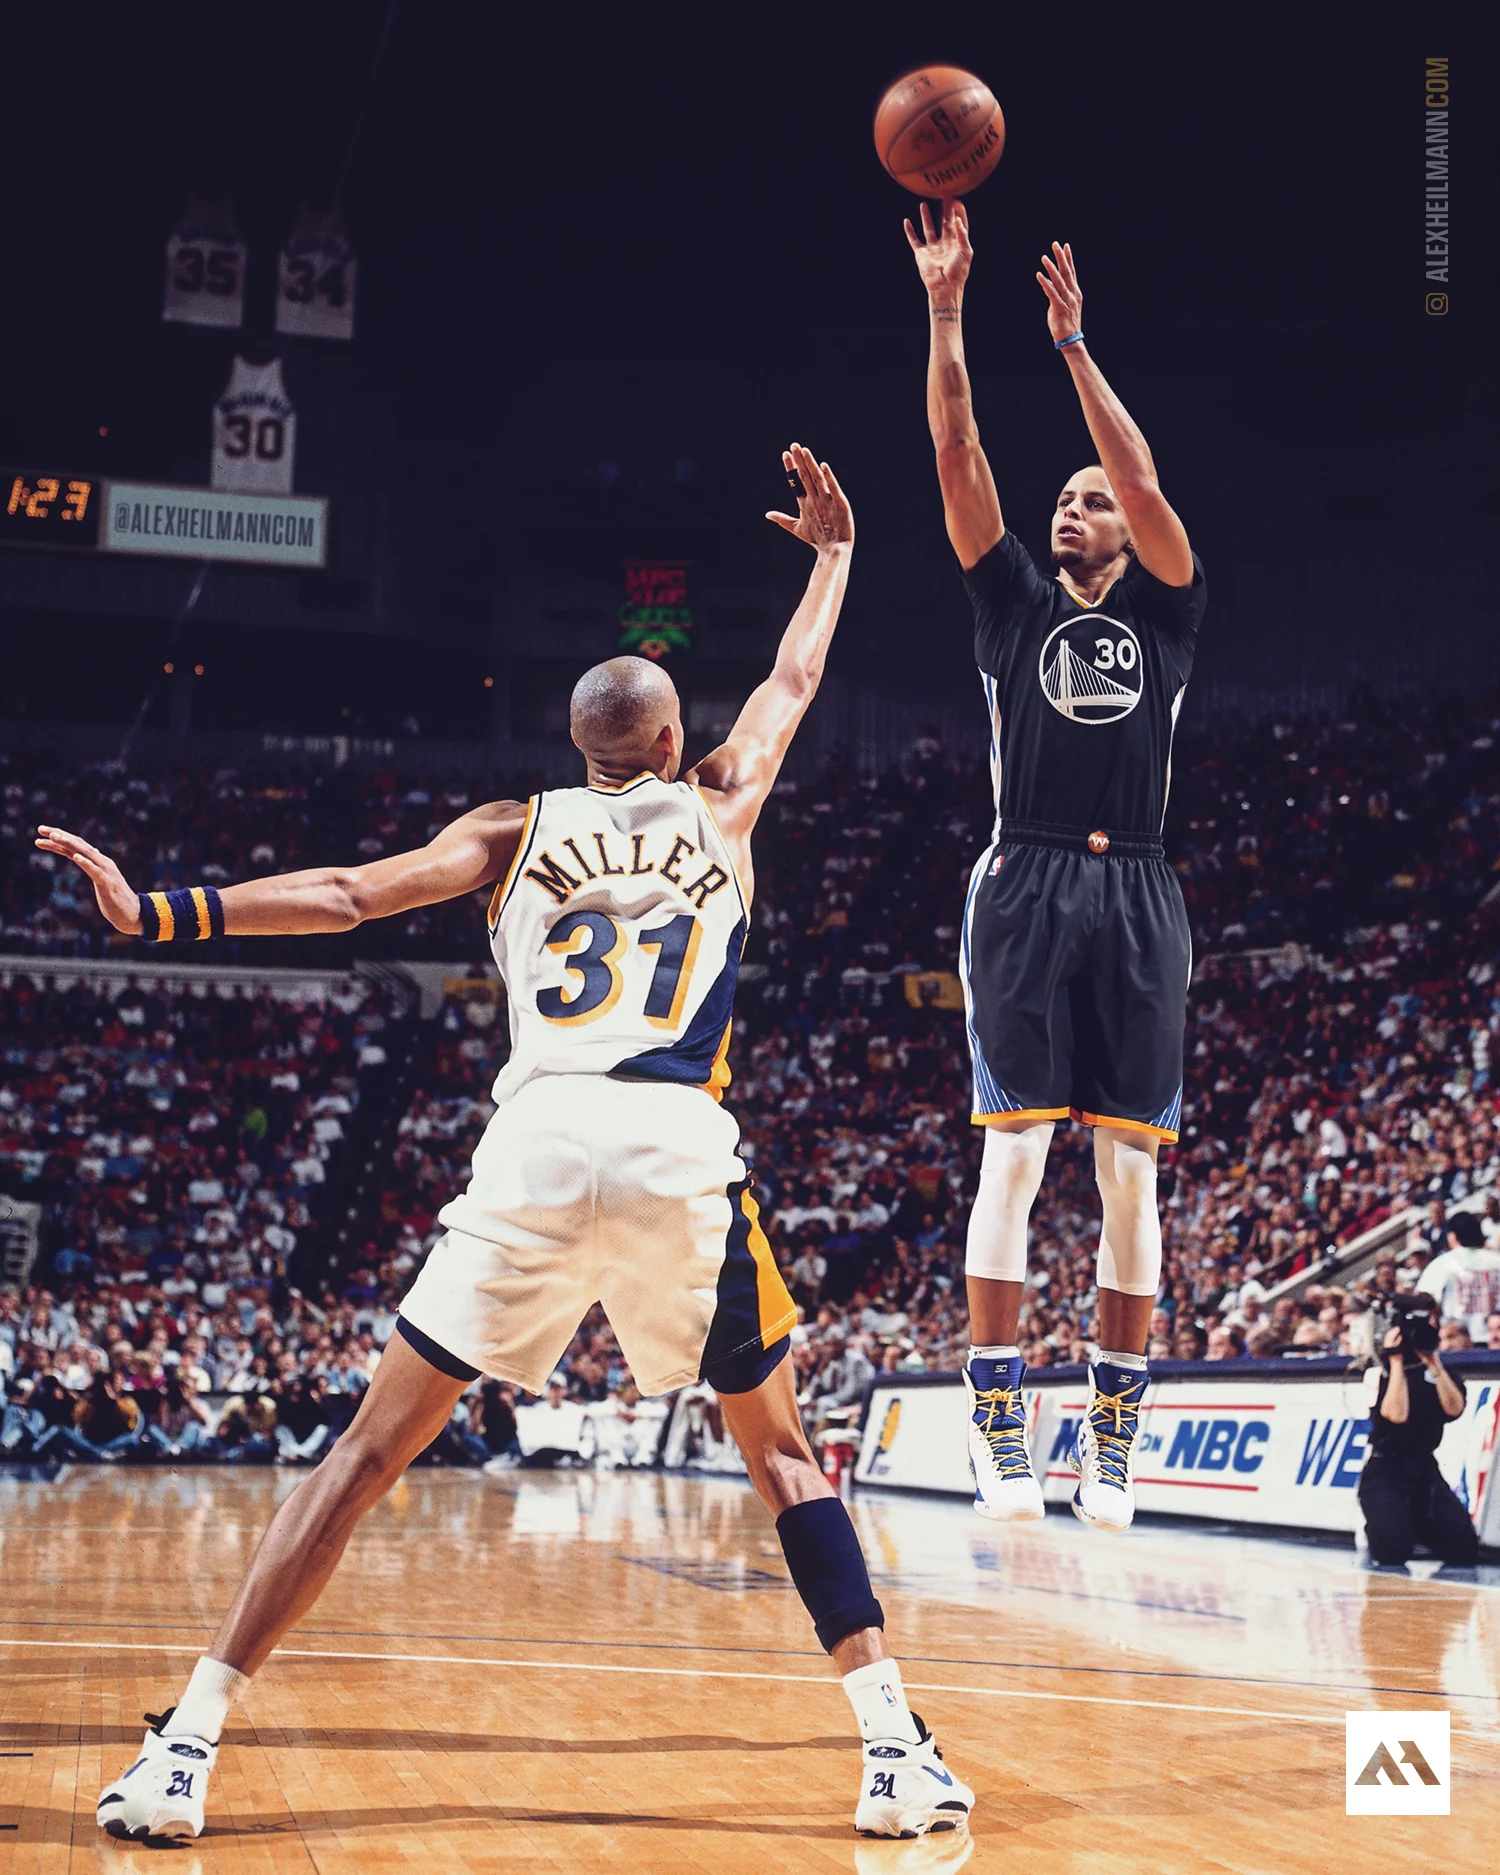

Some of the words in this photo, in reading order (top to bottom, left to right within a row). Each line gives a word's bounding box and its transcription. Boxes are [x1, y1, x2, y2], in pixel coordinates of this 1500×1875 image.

[174, 247, 241, 296] 35
[285, 259, 347, 308] 34
[223, 414, 284, 461] 30
[114, 502, 316, 548] @ALEXHEILMANNCOM
[1093, 637, 1137, 671] 30
[523, 832, 729, 908] MILLER
[536, 909, 704, 1031] 31
[1164, 1419, 1271, 1474] NBC
[165, 1770, 194, 1799] 31
[869, 1772, 897, 1799] 31
